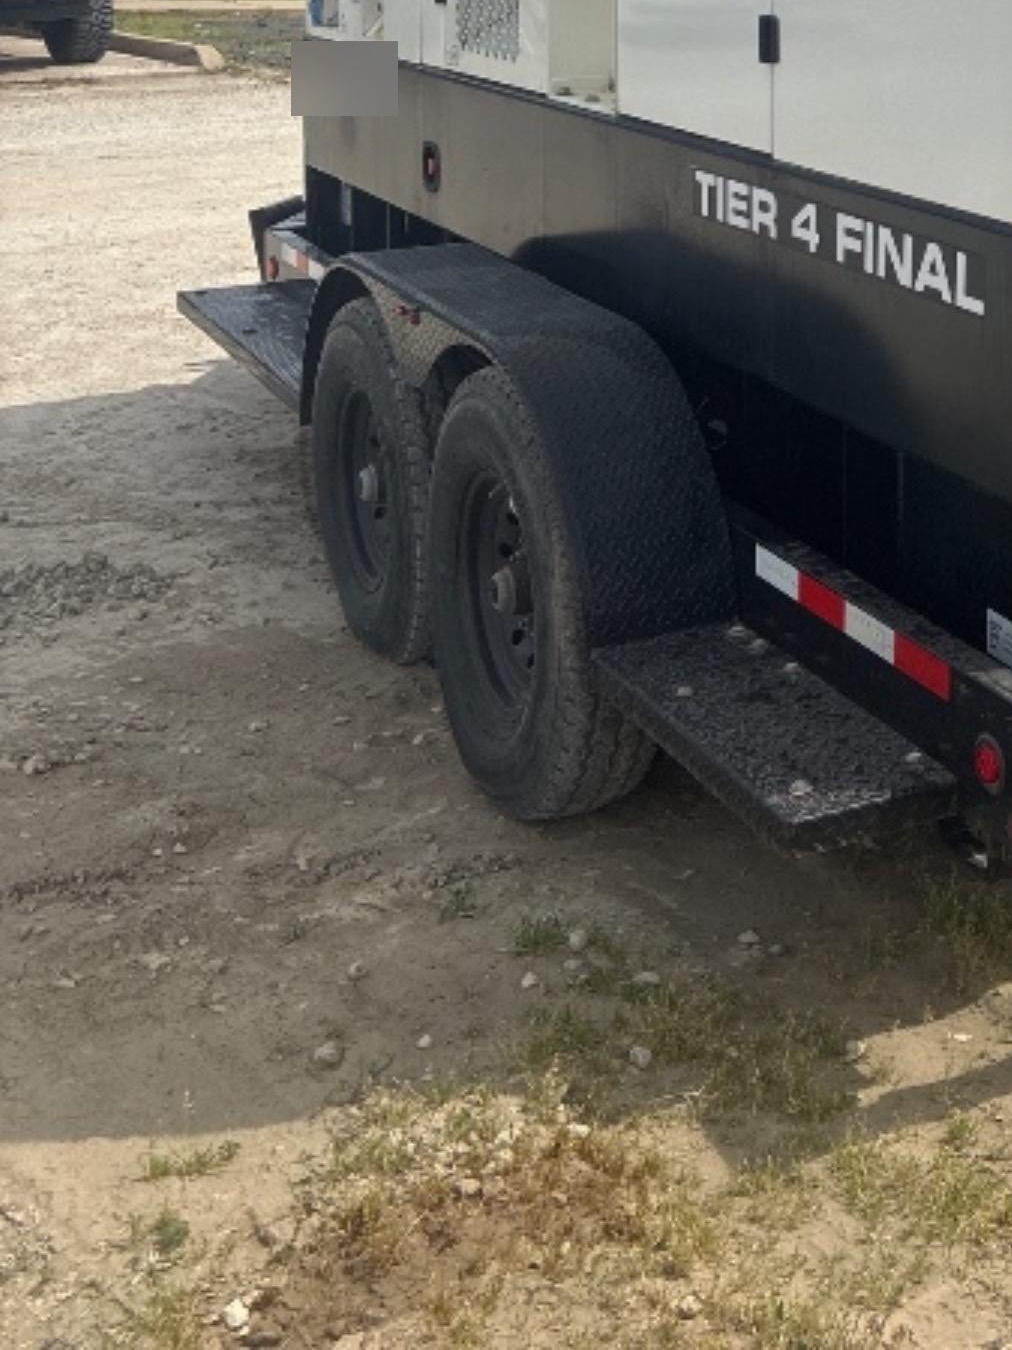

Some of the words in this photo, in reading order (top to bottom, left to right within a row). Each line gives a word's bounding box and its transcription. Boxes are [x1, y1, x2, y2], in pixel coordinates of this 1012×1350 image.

[695, 169, 778, 240] TIER
[791, 203, 820, 253] 4
[836, 212, 985, 316] FINAL
